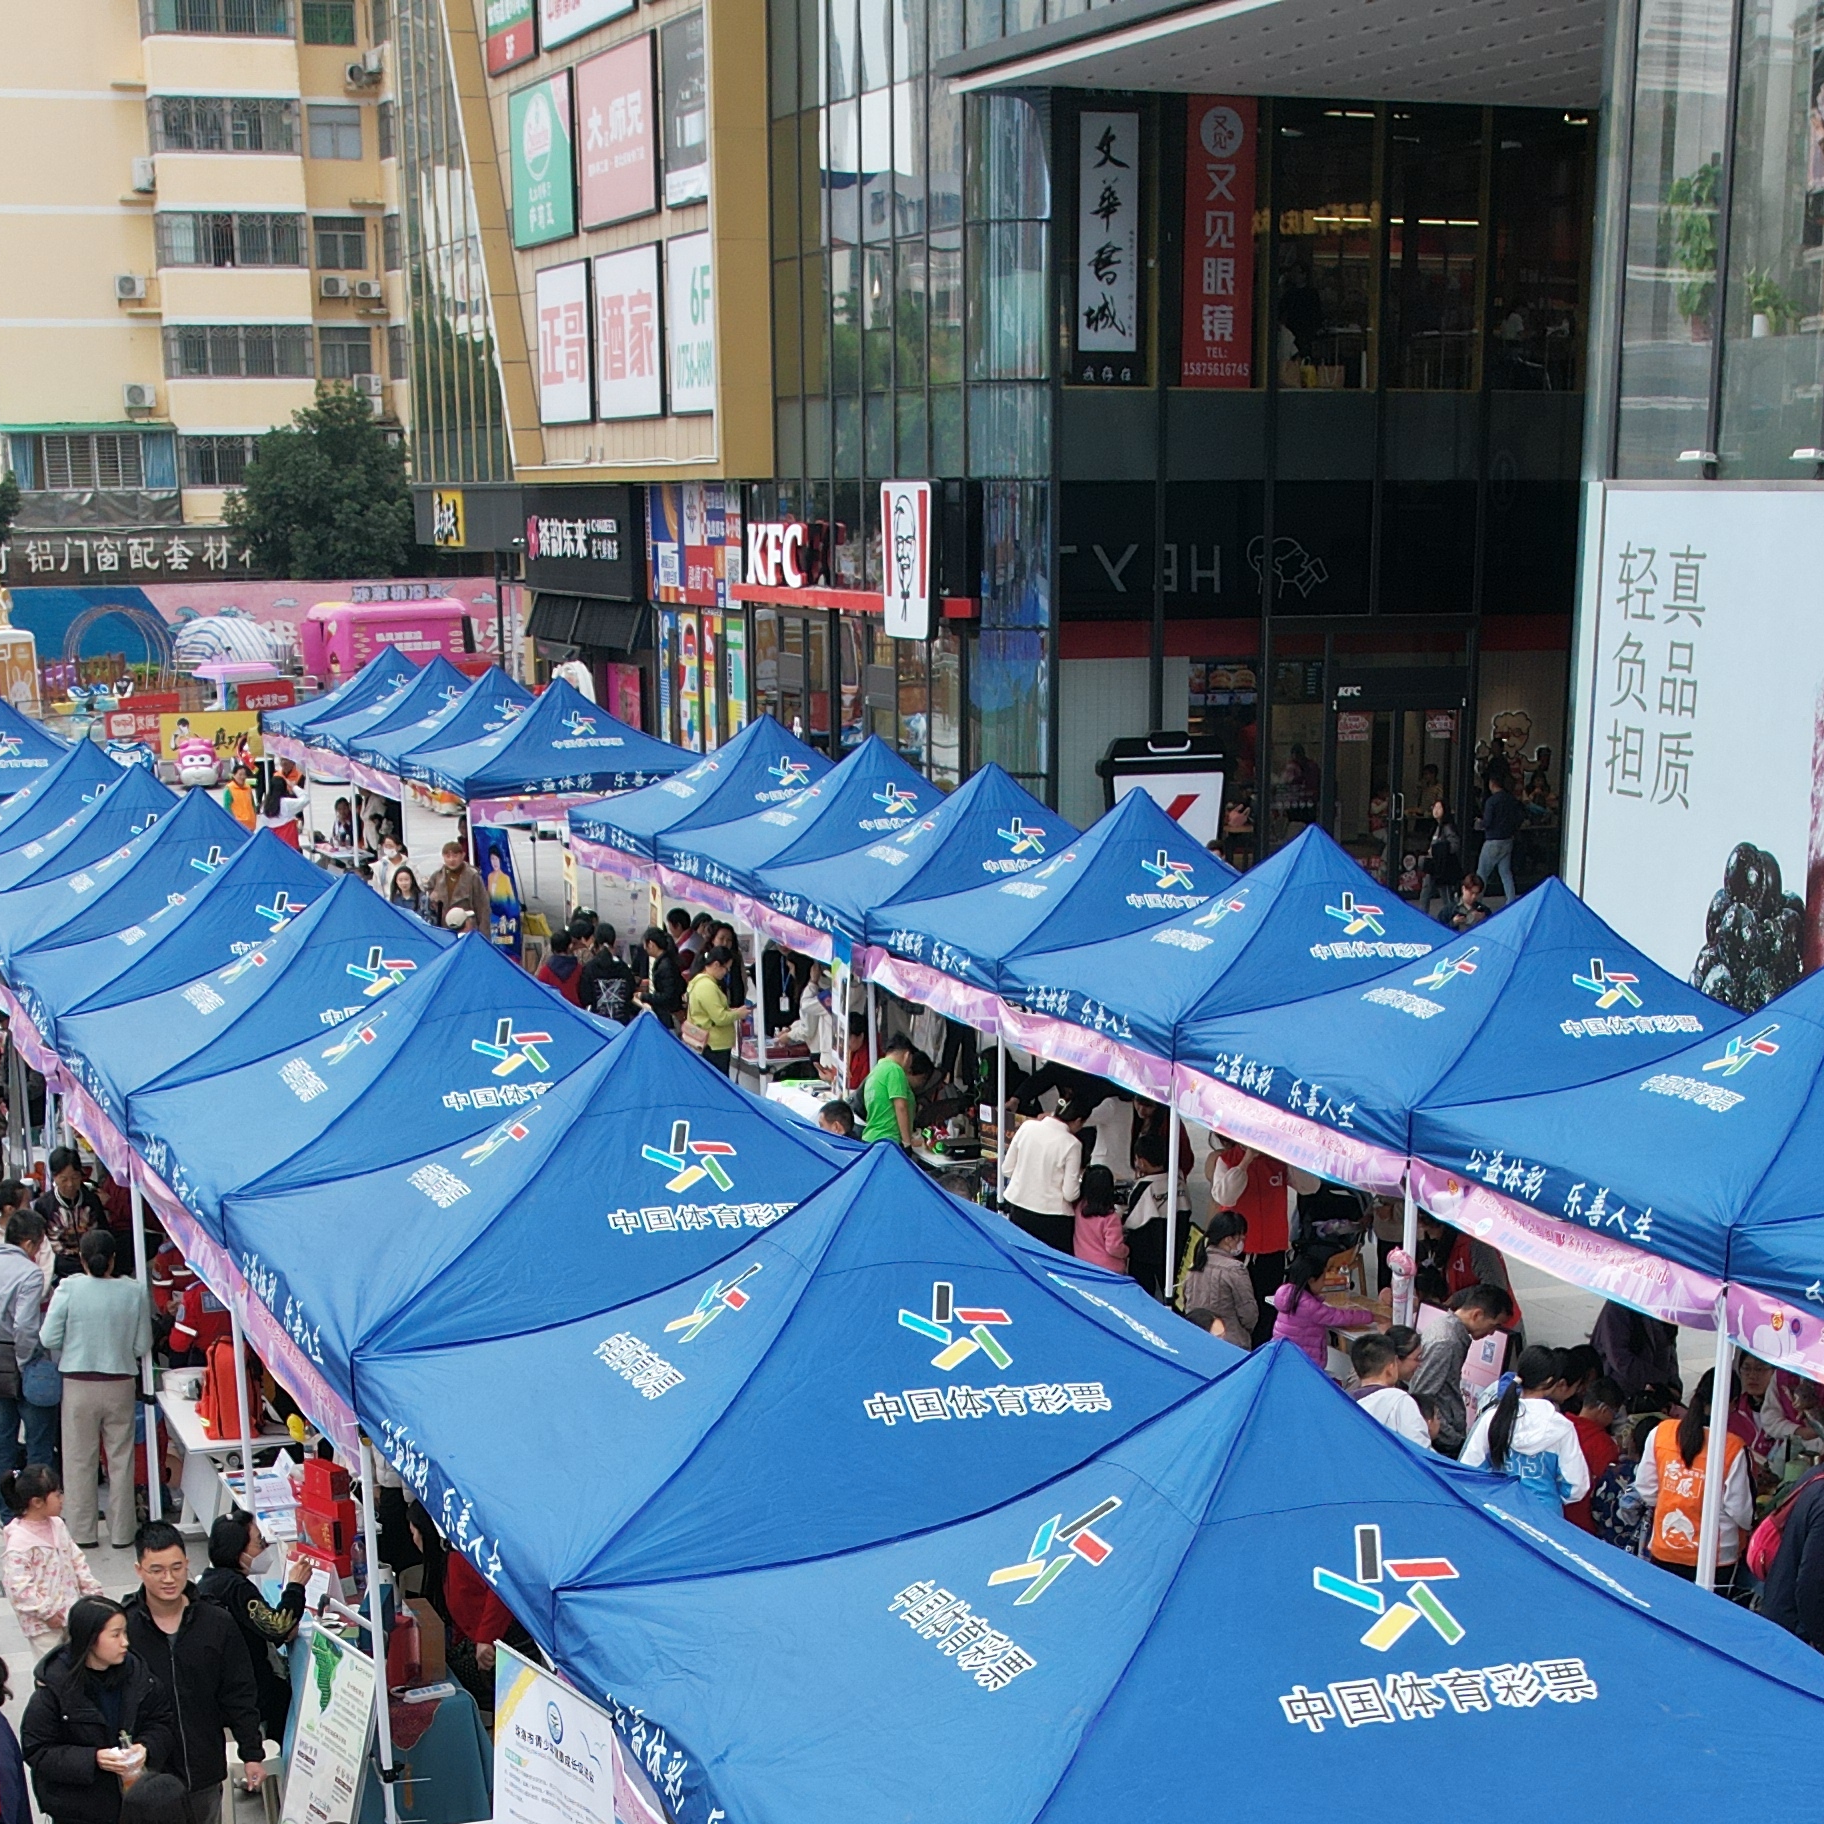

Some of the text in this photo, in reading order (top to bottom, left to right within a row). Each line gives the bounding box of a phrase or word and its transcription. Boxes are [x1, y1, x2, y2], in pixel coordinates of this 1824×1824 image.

[1201, 162, 1237, 343] 又见眼镜
[1182, 361, 1250, 378] 15875616745
[1205, 345, 1228, 359] TEL:
[746, 522, 806, 588] KFC
[1336, 685, 1363, 698] KFC
[1604, 540, 1659, 802] 轻负担
[1649, 544, 1709, 810] 真品质
[1309, 942, 1433, 961] 中国体育彩票
[1079, 999, 1135, 1040] 乐善人生
[1559, 1014, 1704, 1039] 中国体育彩票
[1213, 1052, 1275, 1097] 公益体彩
[1287, 1077, 1356, 1129] 乐善人生
[1638, 1073, 1746, 1114] 中国体育彩票
[1465, 1147, 1547, 1201] 公益体彩
[1563, 1182, 1654, 1243] 乐善人生
[591, 1329, 688, 1401] 中国体育彩票
[861, 1382, 1112, 1427] 中国体育彩票
[888, 1577, 1037, 1693] 中国体育彩票
[1278, 1657, 1599, 1734] 中国体育彩票
